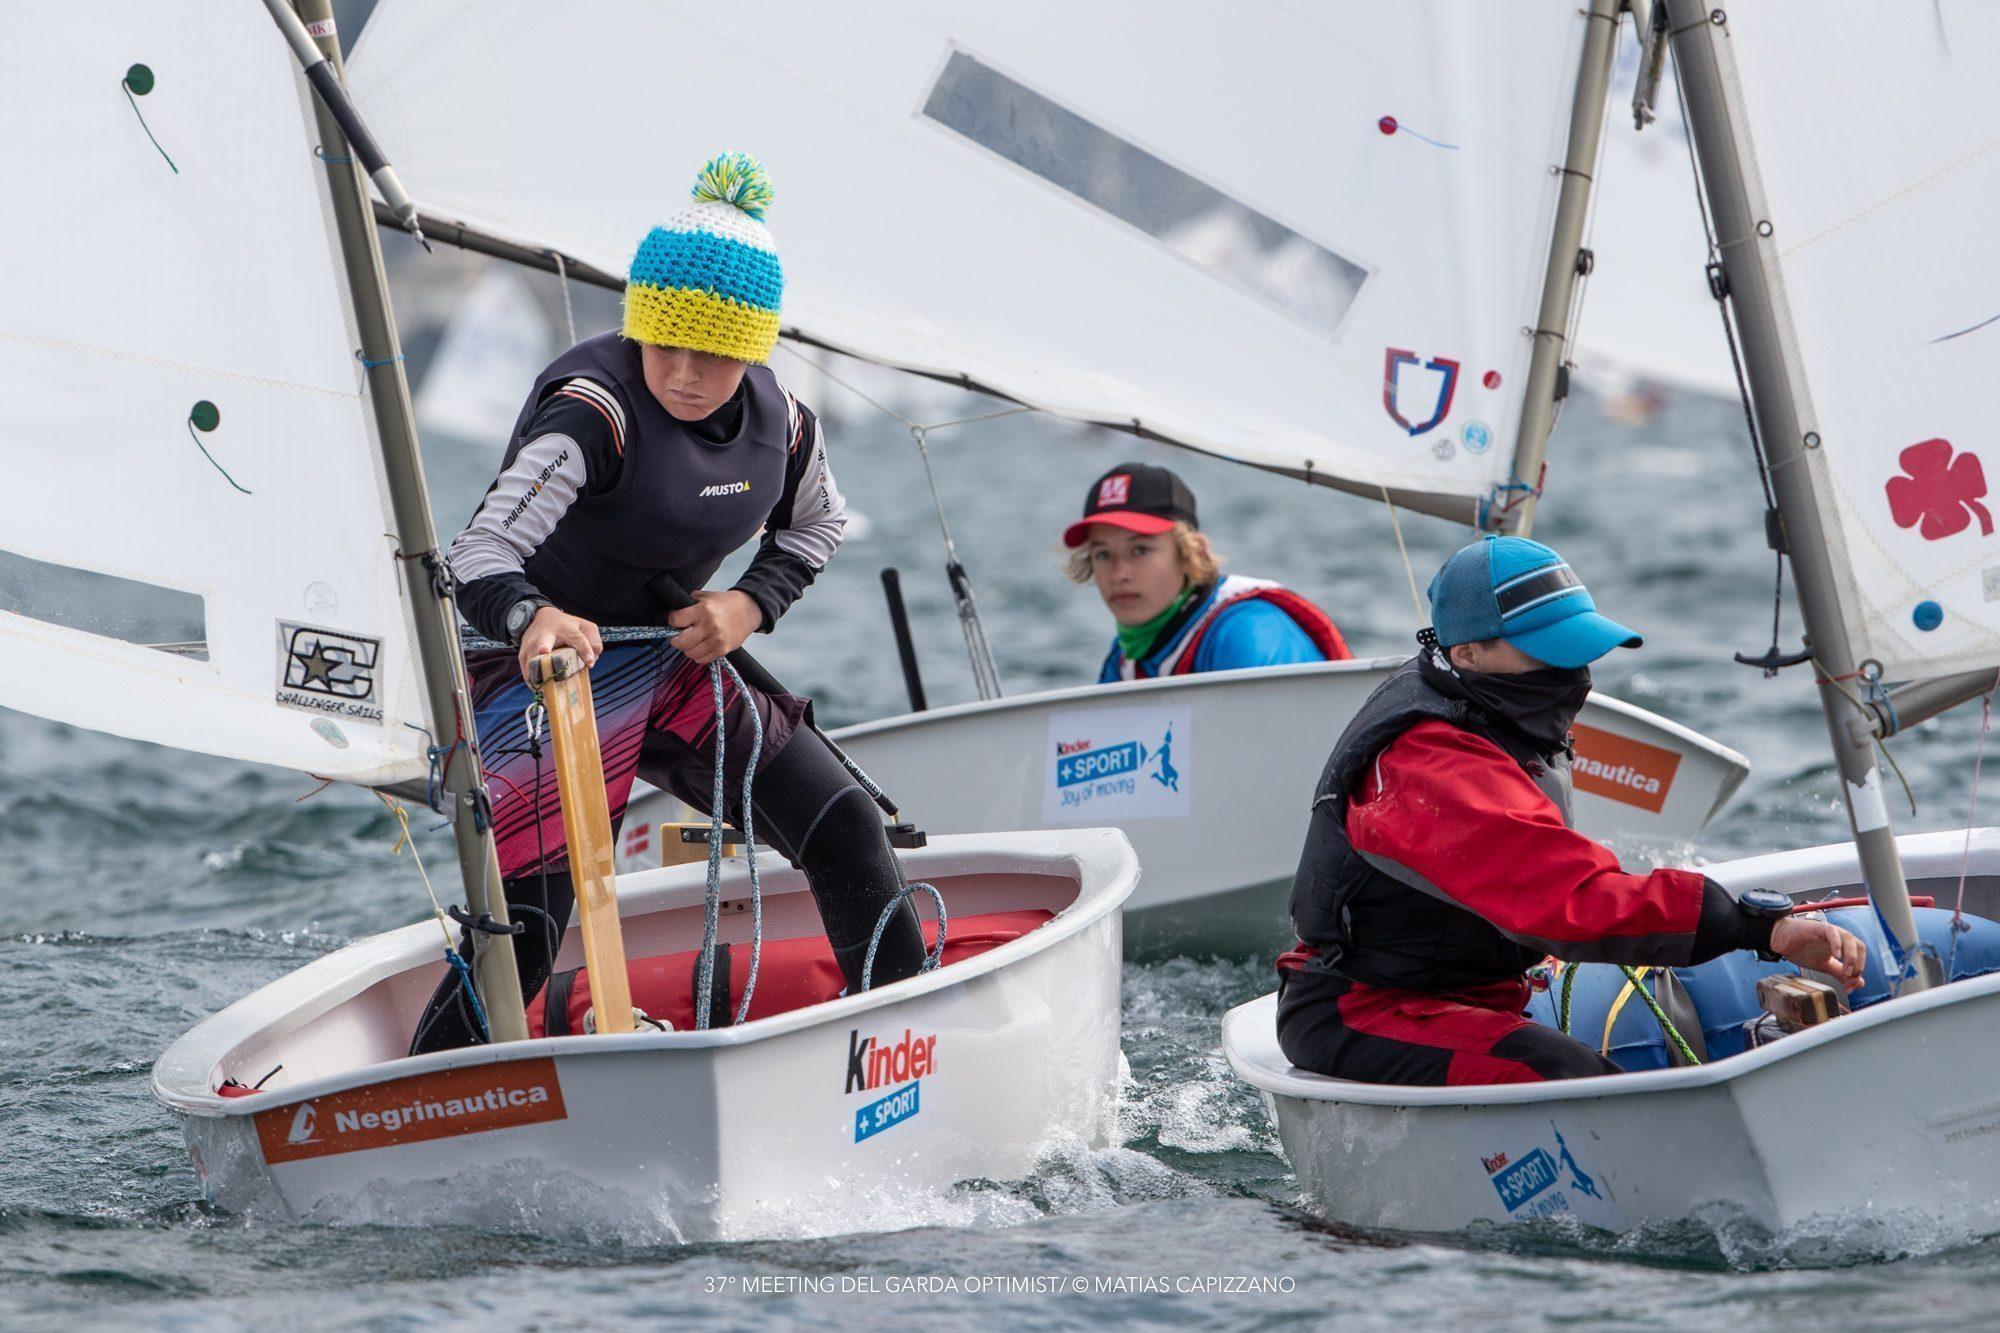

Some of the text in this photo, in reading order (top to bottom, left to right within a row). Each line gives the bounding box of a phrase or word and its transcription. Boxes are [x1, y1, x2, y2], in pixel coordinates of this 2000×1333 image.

[699, 481, 744, 497] MUSTO
[502, 487, 538, 530] MARINE
[275, 691, 383, 720] CHALLENGER SAILS
[1096, 778, 1136, 797] moving
[334, 1085, 548, 1133] Negrinautica
[875, 1087, 916, 1128] SPORT
